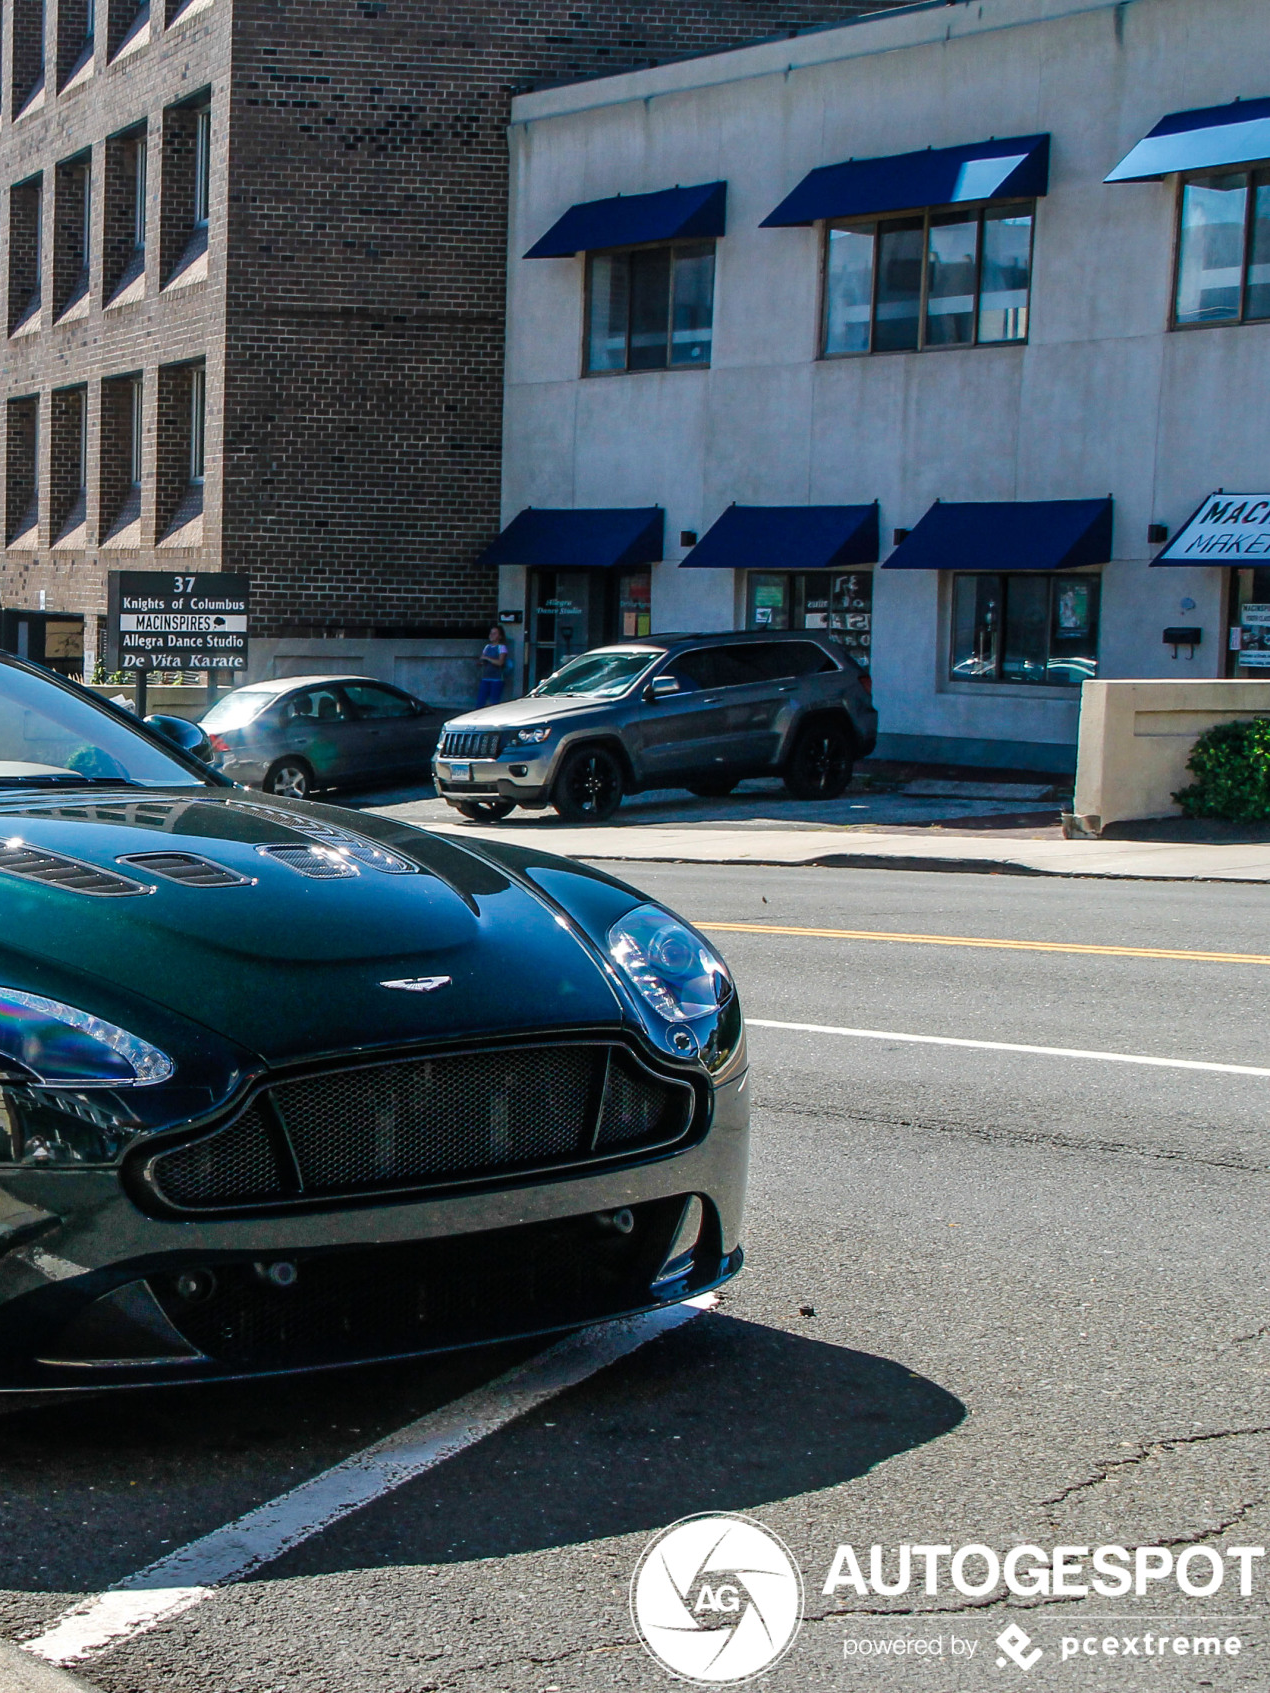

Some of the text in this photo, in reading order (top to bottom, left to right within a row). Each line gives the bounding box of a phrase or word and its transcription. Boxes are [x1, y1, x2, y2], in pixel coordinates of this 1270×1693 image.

[173, 576, 196, 593] 37
[123, 597, 245, 611] Knights of Columbus
[136, 615, 211, 631] MACINSPIRES
[123, 634, 244, 649] Allegra Dance Studio
[122, 654, 243, 667] De Vita Karate
